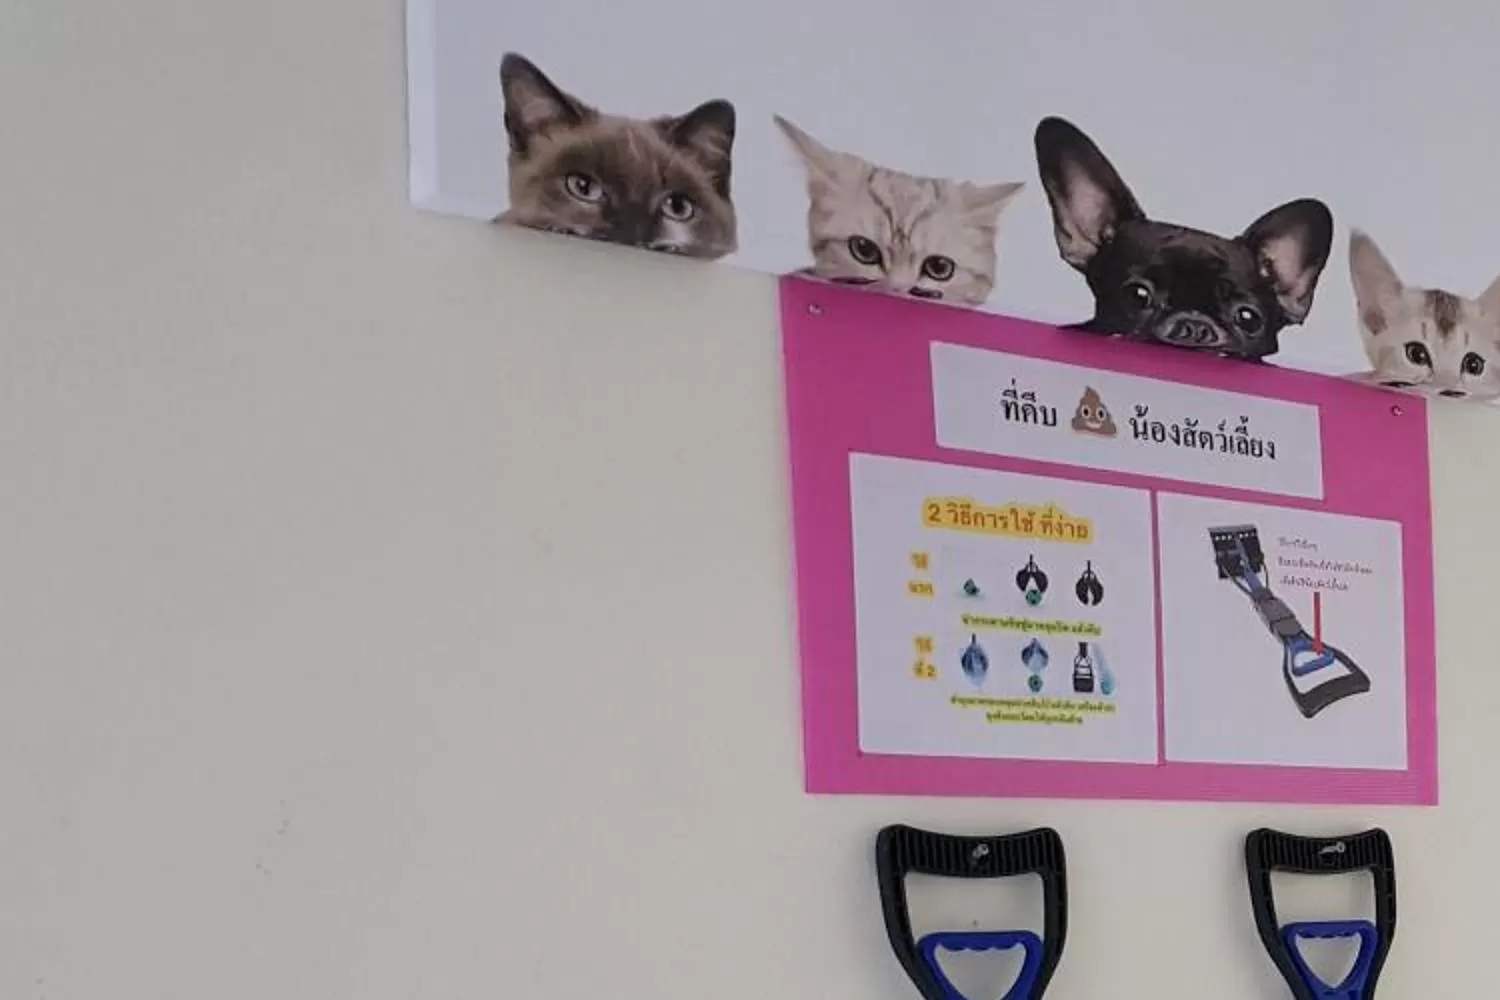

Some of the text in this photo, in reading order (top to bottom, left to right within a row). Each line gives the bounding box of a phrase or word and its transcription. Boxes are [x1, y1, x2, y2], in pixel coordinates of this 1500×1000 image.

[1000, 379, 1276, 460] ที่คีบ น้องสัตว์เลี้ยง
[927, 503, 941, 523] 2
